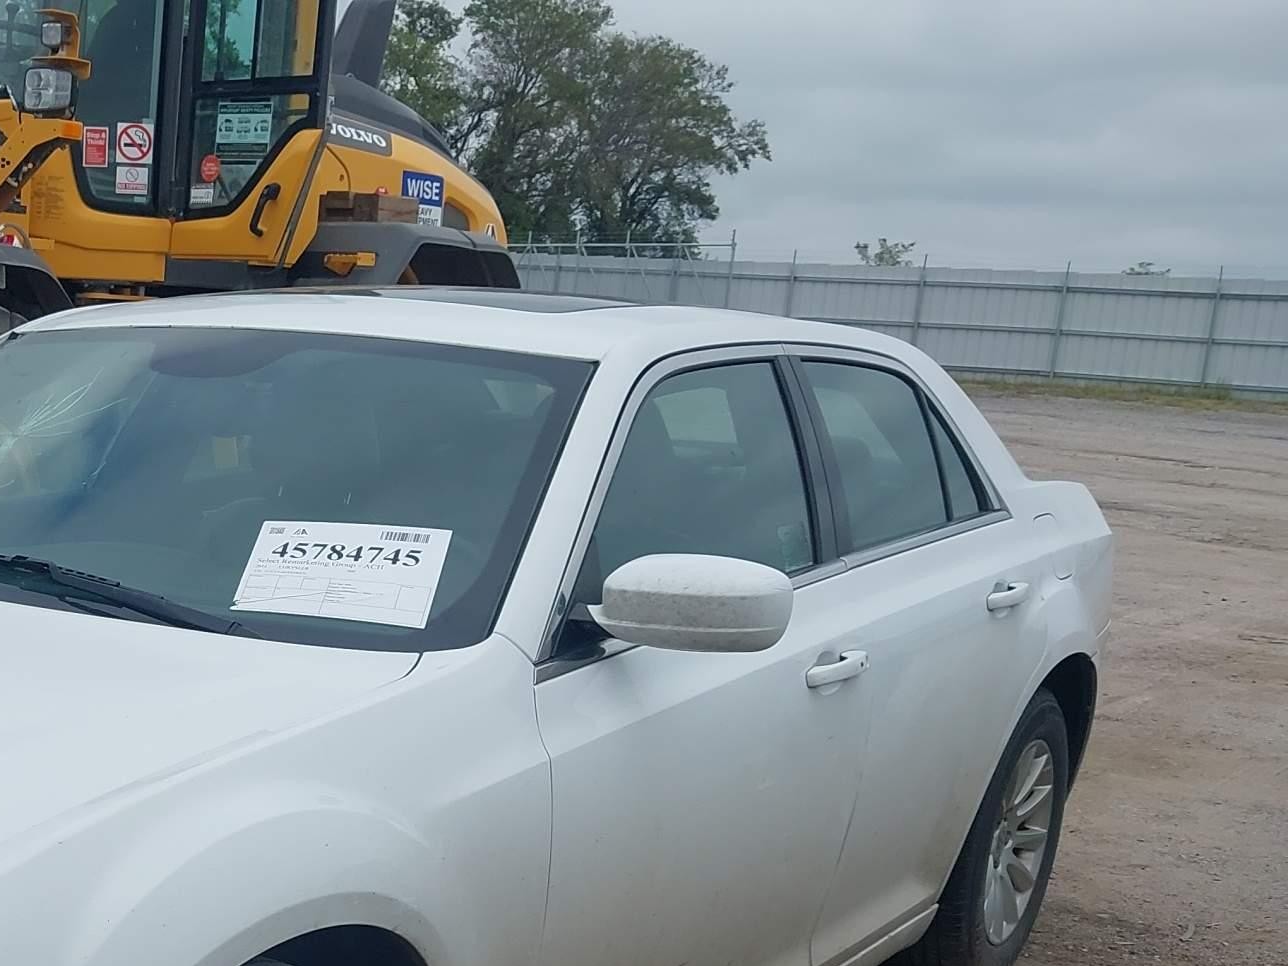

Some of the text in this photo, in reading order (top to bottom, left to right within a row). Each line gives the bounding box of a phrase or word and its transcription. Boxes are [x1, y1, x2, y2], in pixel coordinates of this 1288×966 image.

[407, 178, 441, 201] WISE
[272, 541, 423, 567] 45784745
[282, 559, 331, 568] Remarketing
